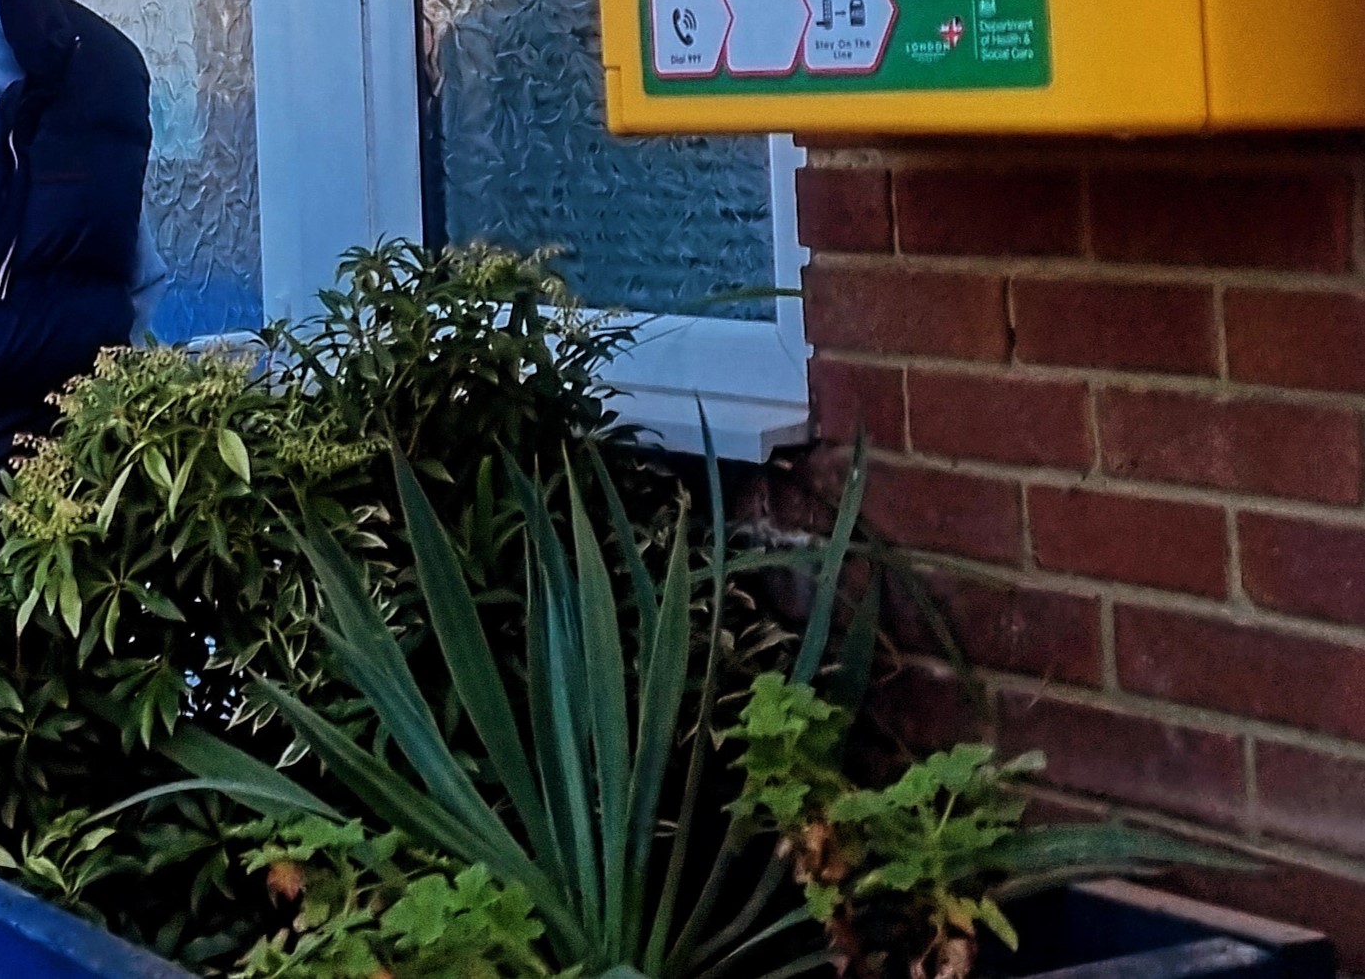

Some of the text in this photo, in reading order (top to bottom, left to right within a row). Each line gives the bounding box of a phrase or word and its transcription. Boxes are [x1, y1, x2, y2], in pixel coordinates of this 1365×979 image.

[980, 19, 1034, 33] Department
[815, 39, 871, 50] Stay On The
[906, 40, 951, 53] LONDON
[834, 50, 852, 60] Line
[981, 48, 1009, 61] Social
